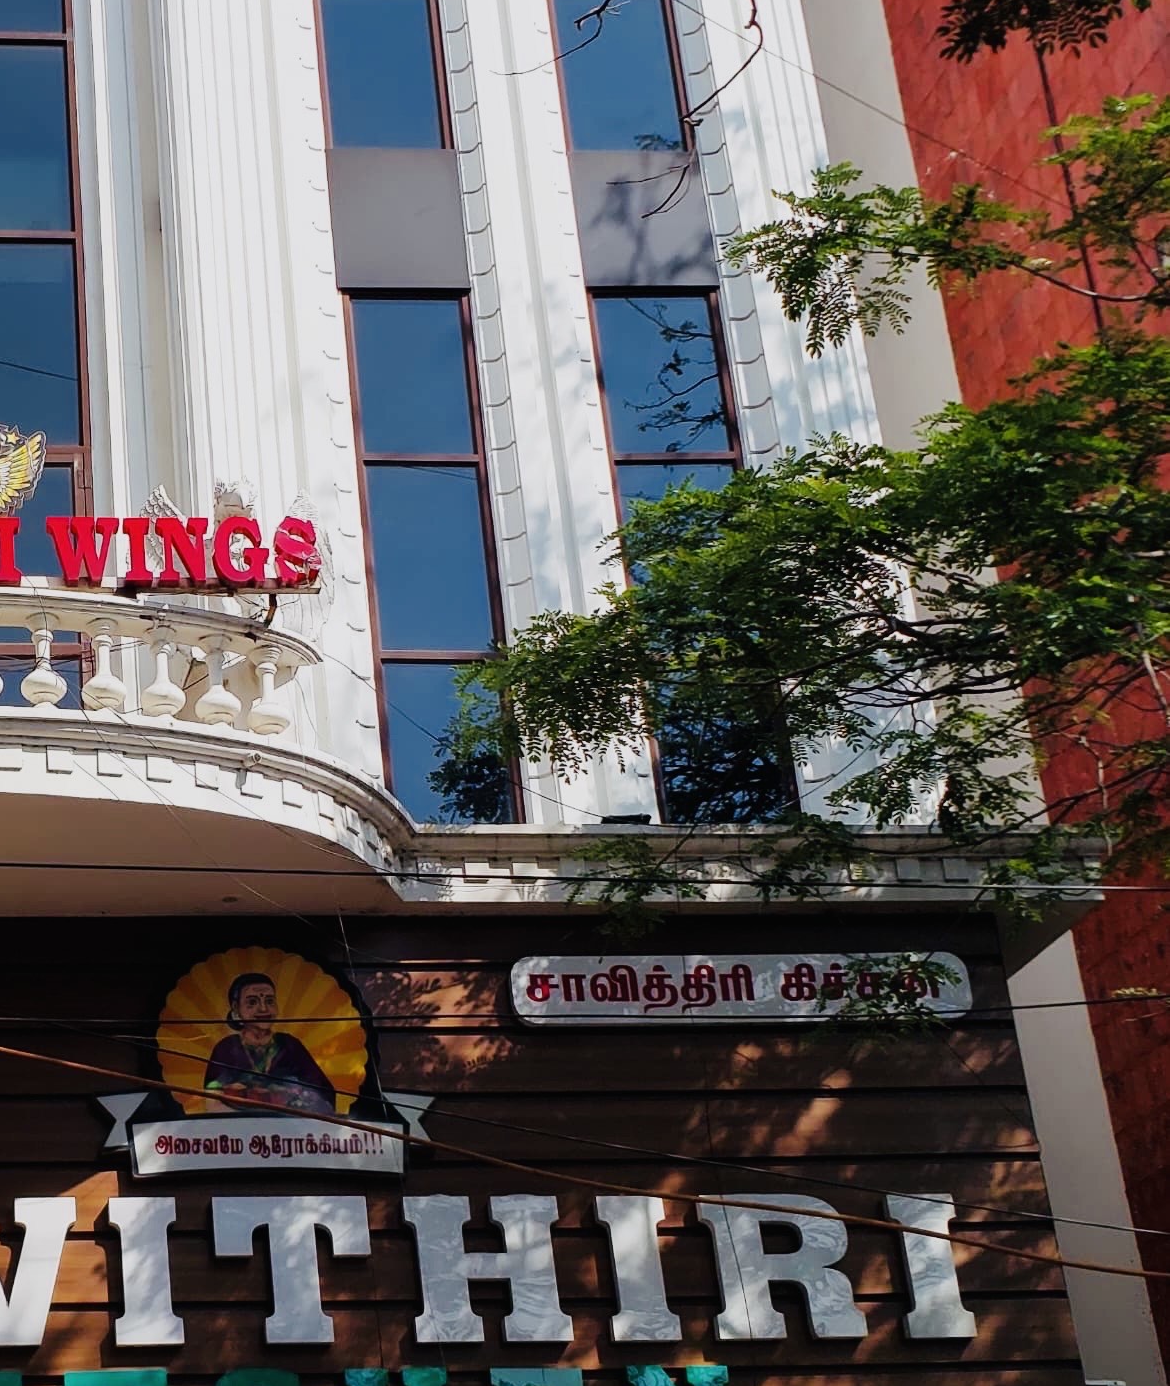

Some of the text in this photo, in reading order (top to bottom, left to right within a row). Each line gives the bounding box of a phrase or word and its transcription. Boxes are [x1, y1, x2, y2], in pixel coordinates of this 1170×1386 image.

[46, 514, 322, 587] WINGS
[526, 964, 754, 1013] சாவித்திரி
[155, 1134, 243, 1155] அசைவமே
